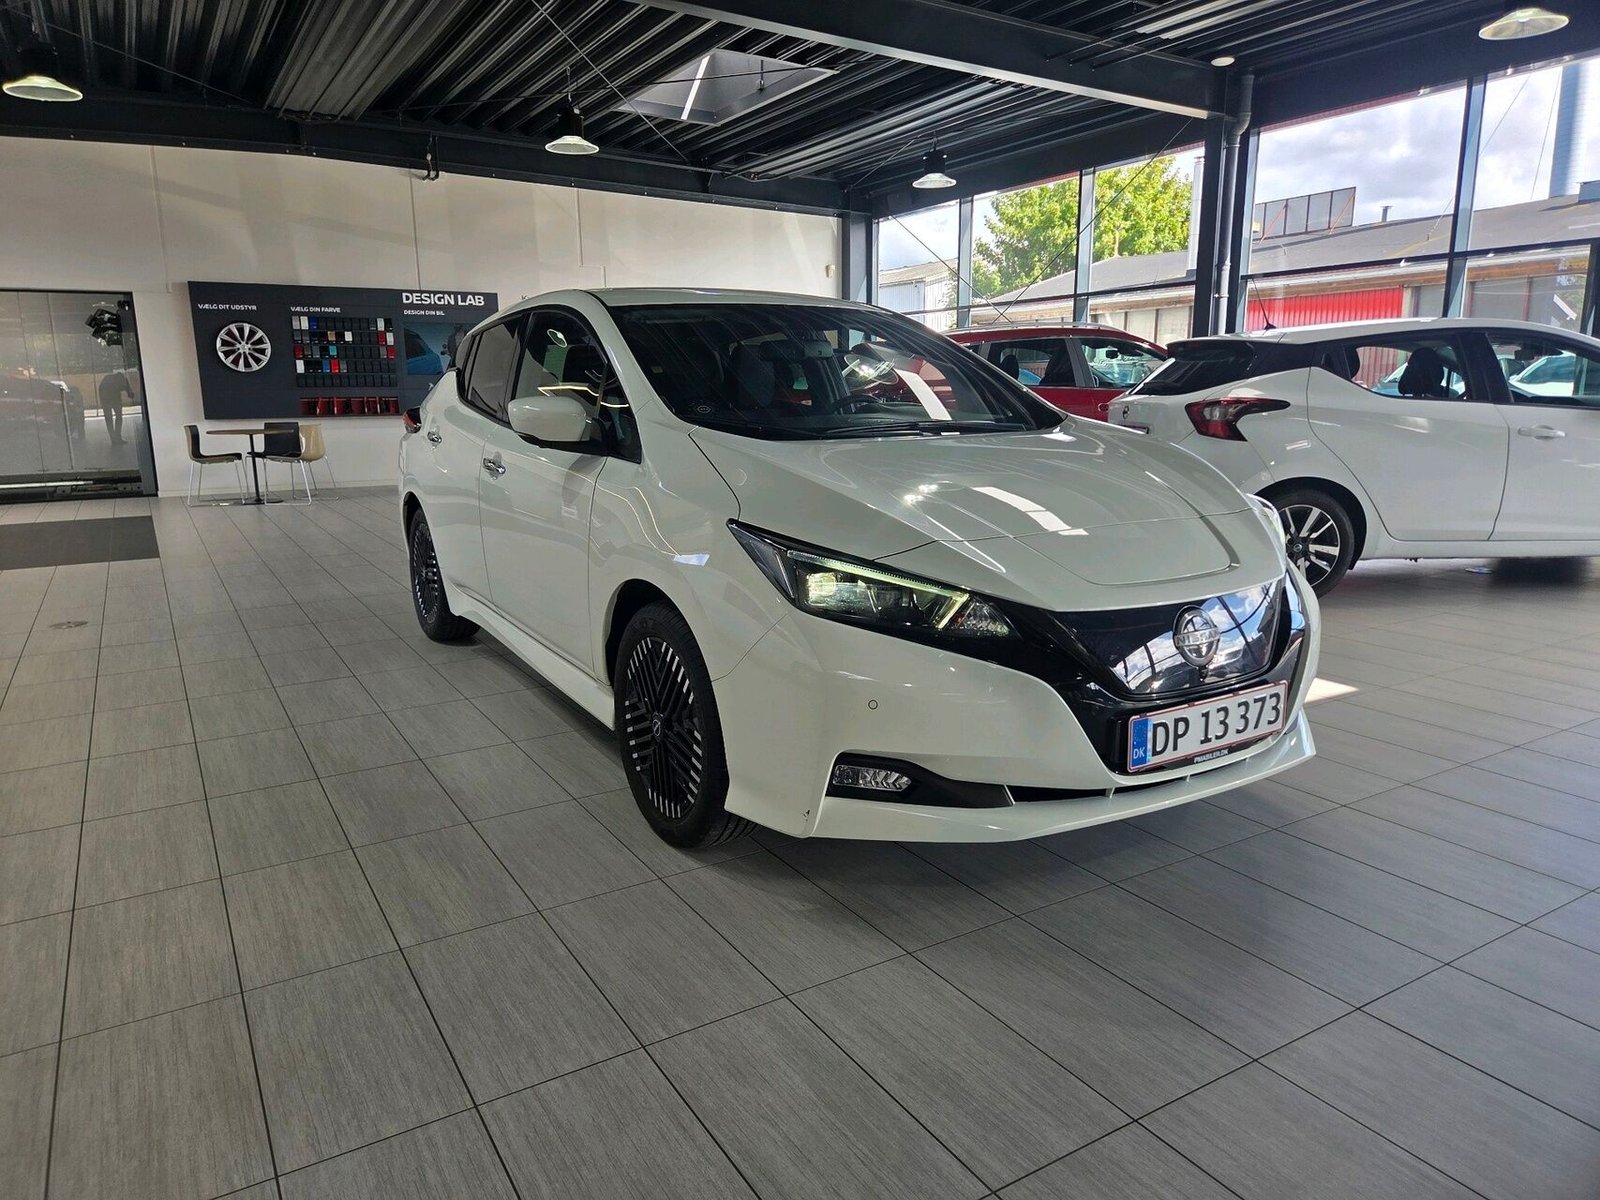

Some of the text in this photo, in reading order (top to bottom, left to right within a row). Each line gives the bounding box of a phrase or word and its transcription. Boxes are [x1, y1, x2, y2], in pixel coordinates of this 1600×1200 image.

[401, 292, 485, 306] DESIGN LAB
[1151, 691, 1281, 757] DP 13 373
[1133, 746, 1146, 760] DK
